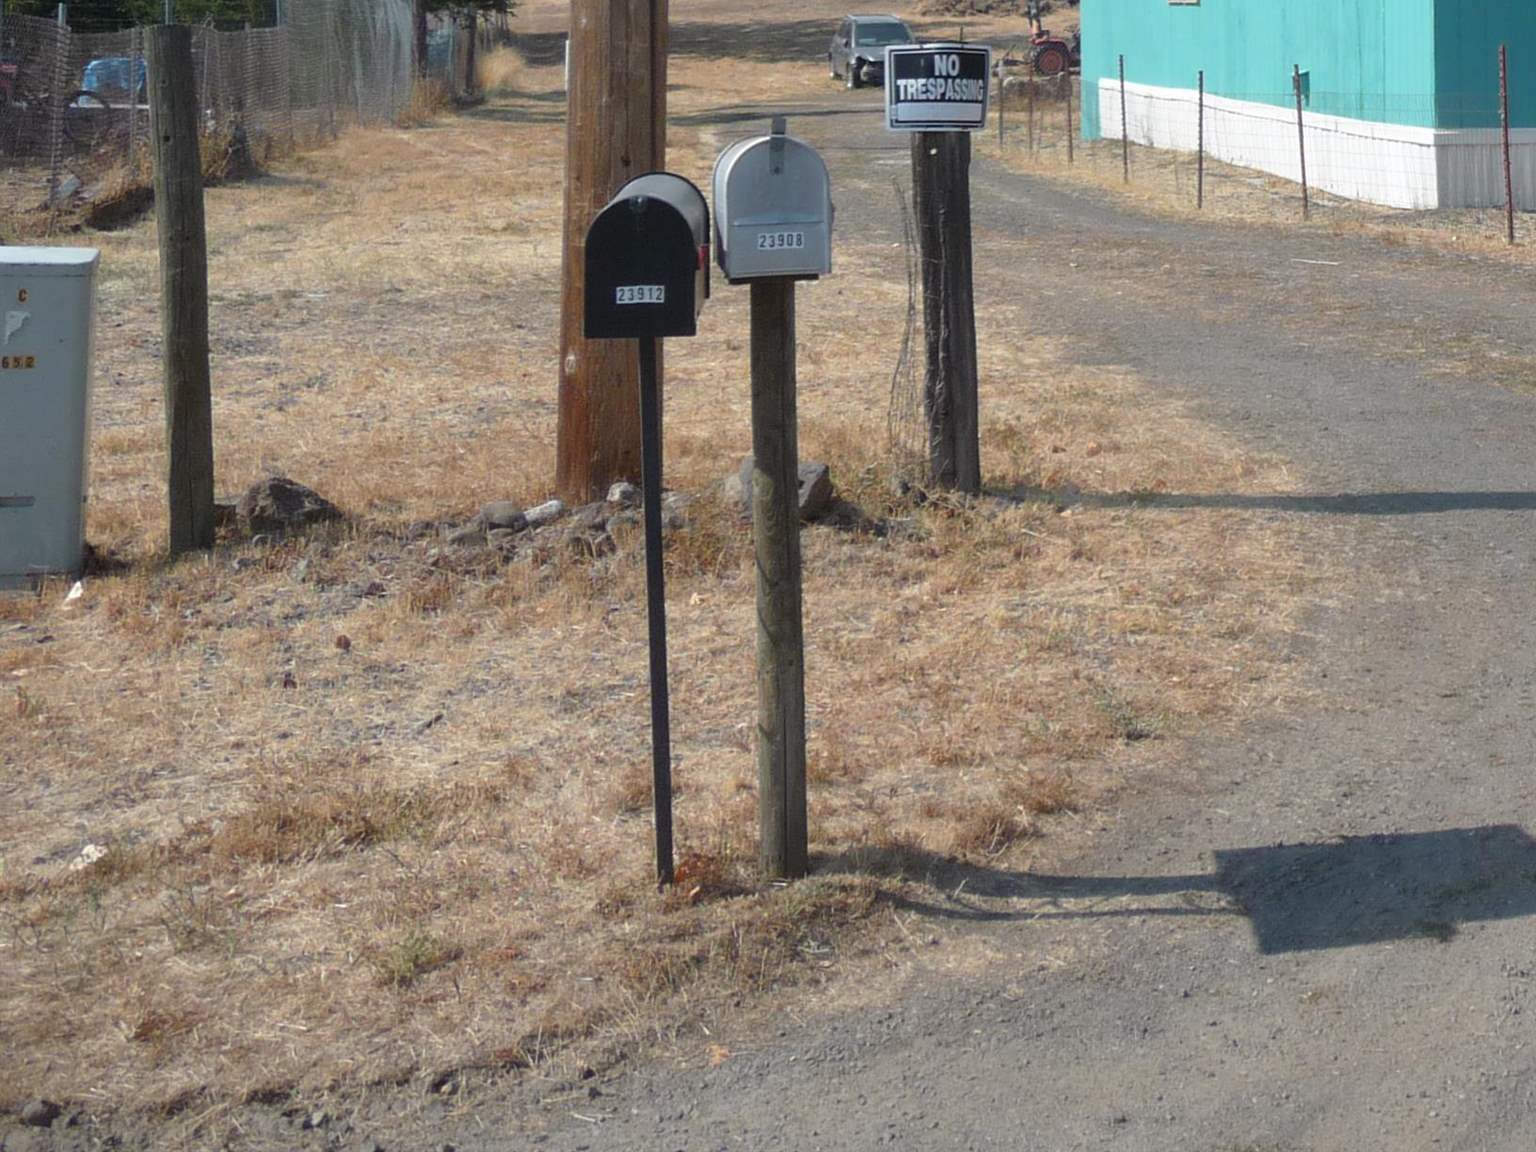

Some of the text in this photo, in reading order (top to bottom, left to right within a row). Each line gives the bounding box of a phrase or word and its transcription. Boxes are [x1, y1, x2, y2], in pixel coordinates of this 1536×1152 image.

[934, 54, 960, 76] NO
[896, 79, 984, 100] TRESPASSING
[759, 233, 803, 248] 23908
[618, 287, 663, 302] 23912
